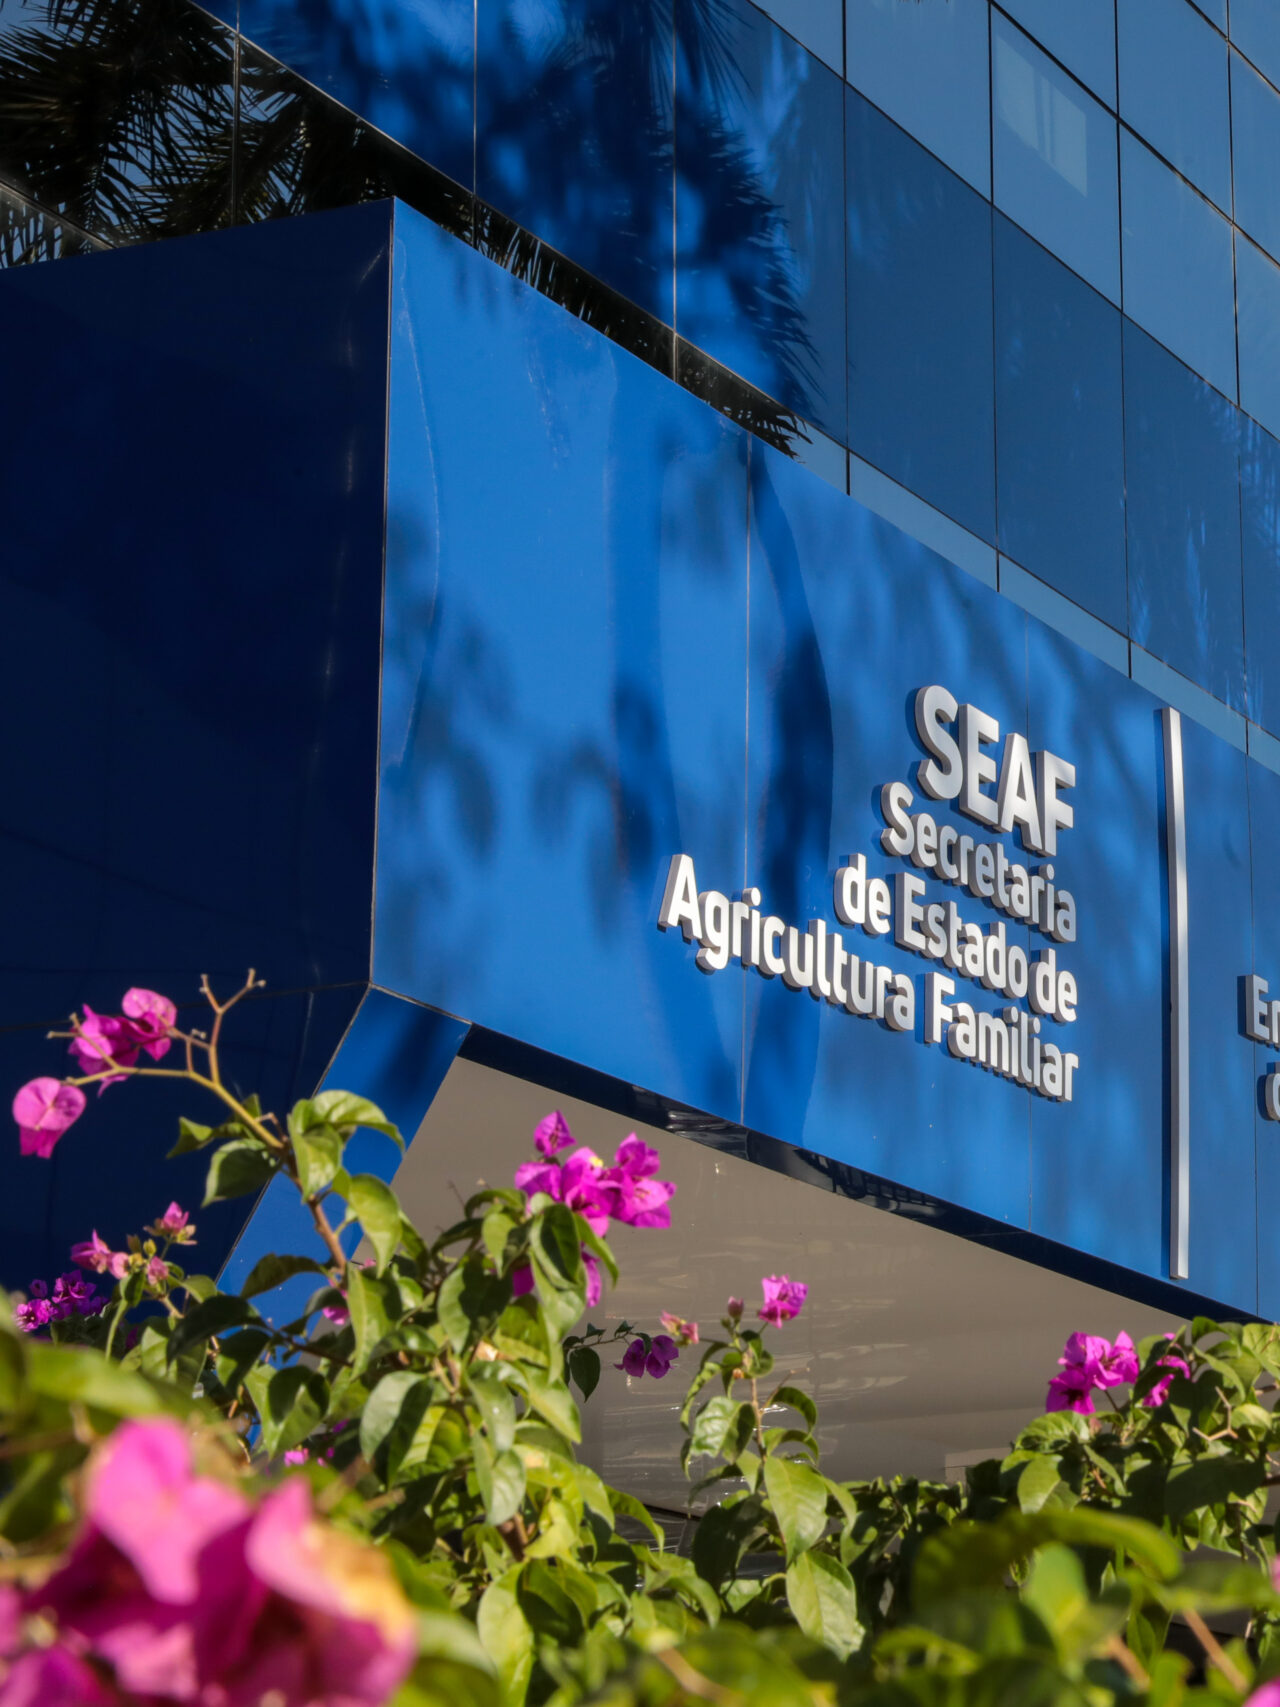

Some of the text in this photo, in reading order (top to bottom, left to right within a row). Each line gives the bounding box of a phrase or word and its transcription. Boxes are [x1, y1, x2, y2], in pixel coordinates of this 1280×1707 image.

[915, 685, 1076, 856] SEAF
[834, 853, 1078, 1022] de Estado de
[881, 781, 1076, 942] Secretaria
[658, 853, 1079, 1101] Agricultura Familiar
